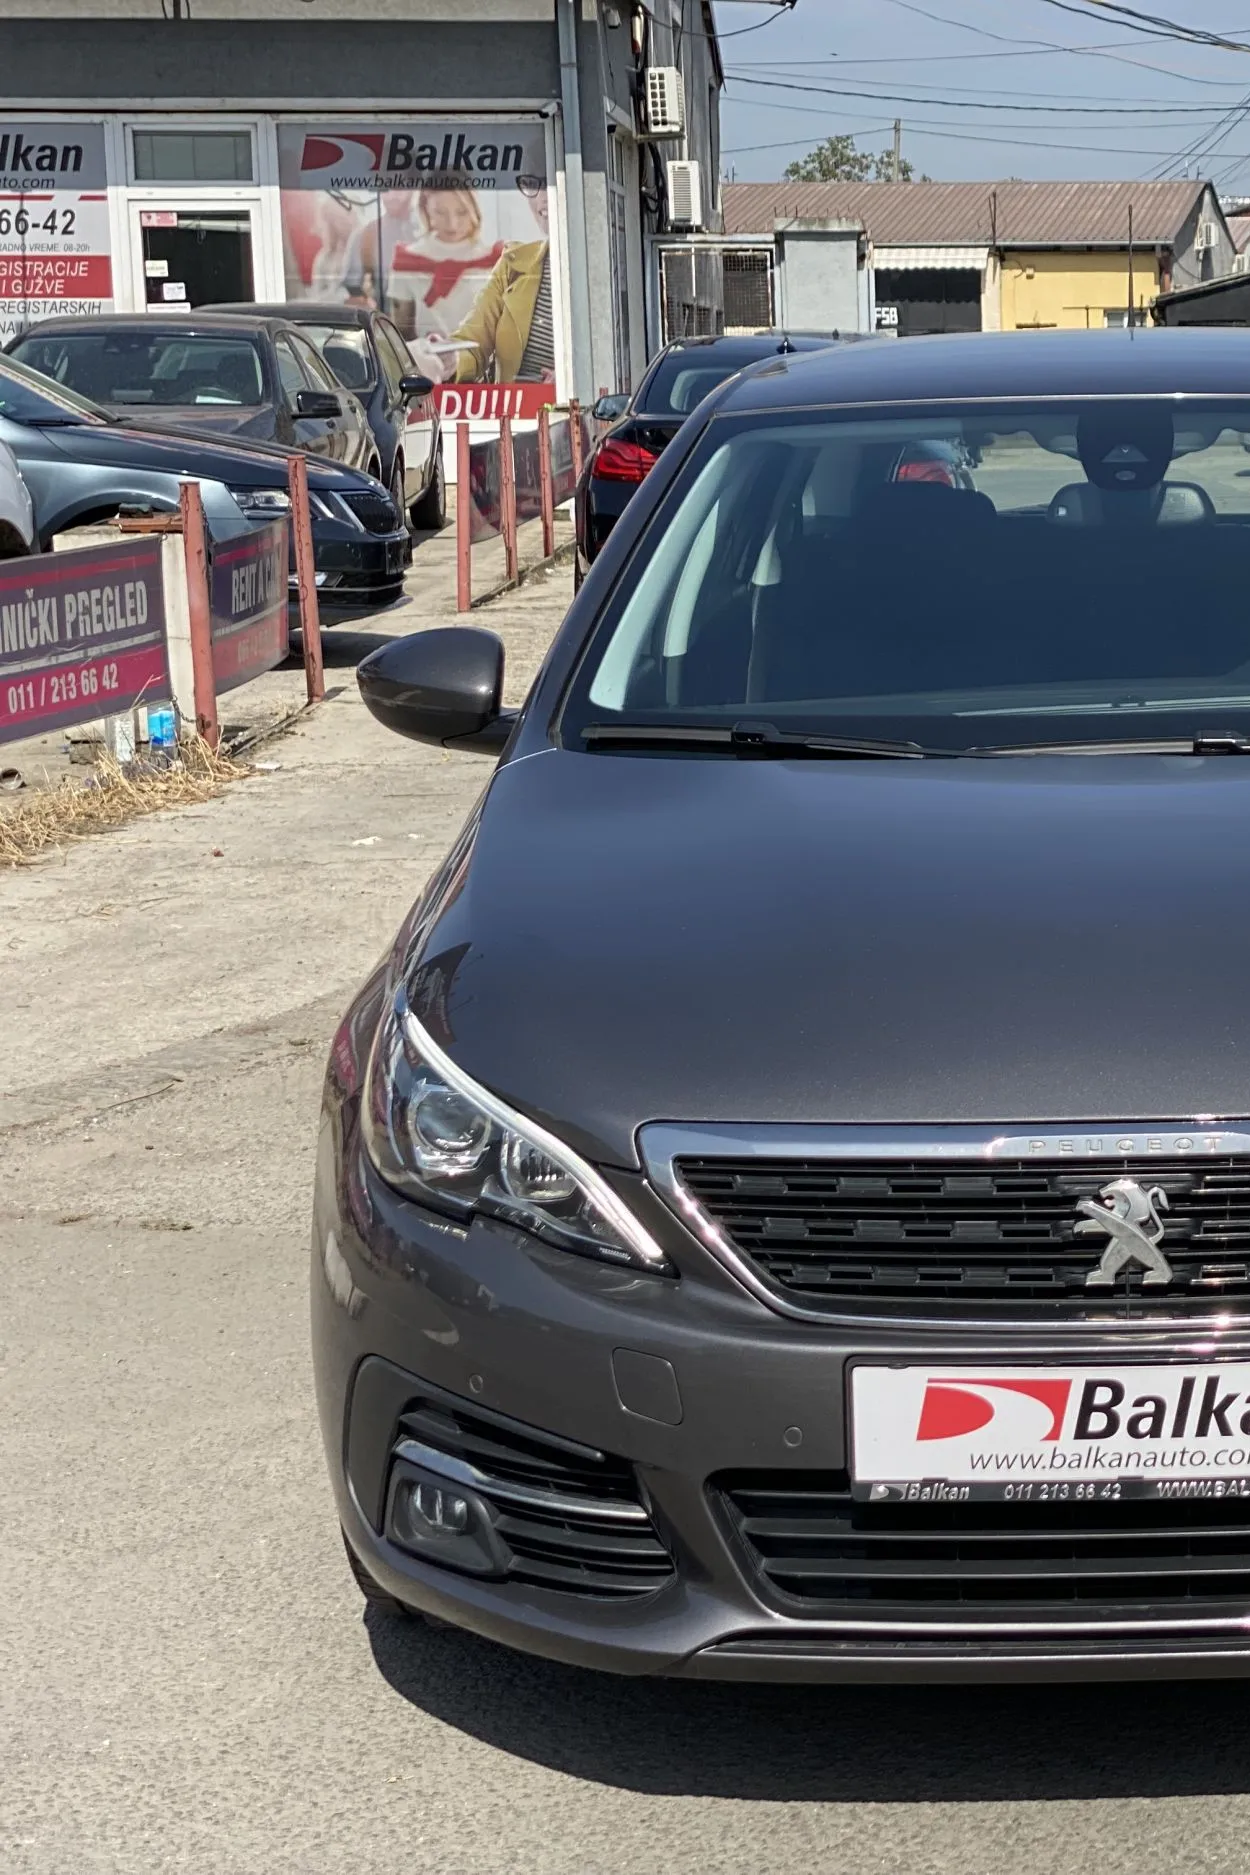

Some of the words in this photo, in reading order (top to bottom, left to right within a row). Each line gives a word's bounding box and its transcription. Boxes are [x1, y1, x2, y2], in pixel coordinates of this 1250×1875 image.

[387, 133, 523, 171] Balkan
[330, 173, 497, 189] www.balkanauto.com
[11, 276, 65, 294] GUŽVE
[231, 563, 257, 615] RENT
[0, 588, 58, 654] NIČKI
[64, 580, 149, 640] PREGLED
[8, 681, 35, 714] 011
[50, 672, 77, 703] 213
[80, 668, 98, 696] 66
[102, 662, 118, 690] 42
[1028, 1136, 1223, 1153] PEUGEOT
[908, 1483, 970, 1500] Balkan
[1004, 1483, 1033, 1499] 011
[1039, 1483, 1069, 1499] 213
[1074, 1483, 1096, 1499] 66
[1100, 1483, 1122, 1499] 42
